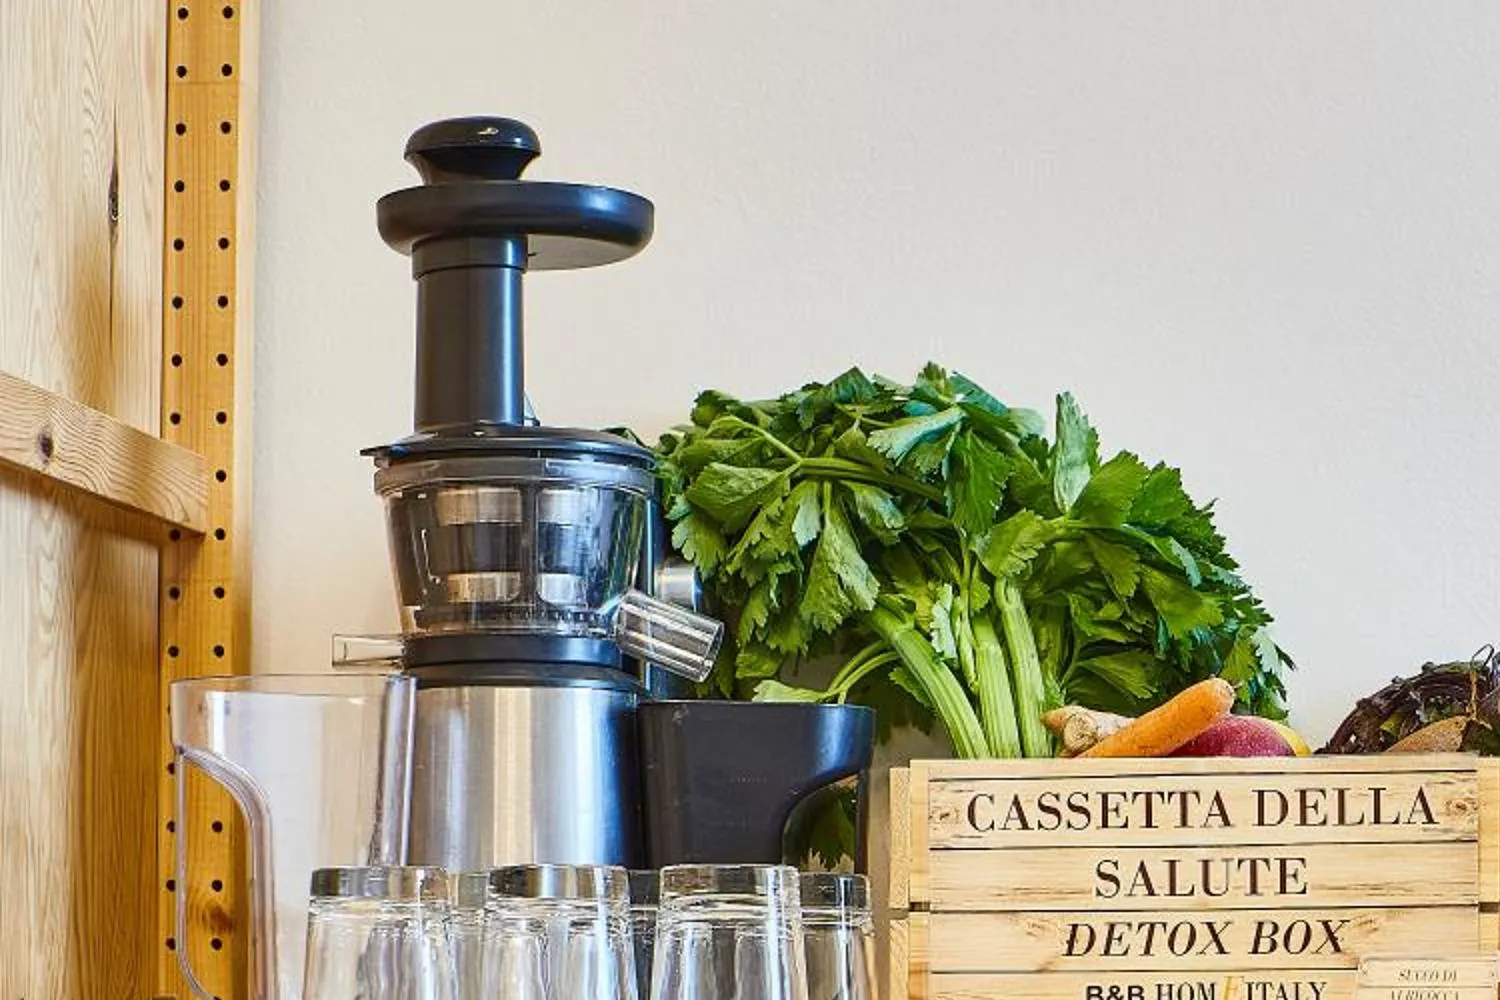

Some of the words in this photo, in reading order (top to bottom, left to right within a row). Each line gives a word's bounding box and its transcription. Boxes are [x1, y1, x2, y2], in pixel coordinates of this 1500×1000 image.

[966, 790, 1233, 832] CASSETTA
[1253, 786, 1440, 827] DELLA
[1095, 856, 1309, 899] SALUTE
[1063, 919, 1234, 959] DETOX
[1247, 917, 1351, 956] BOX
